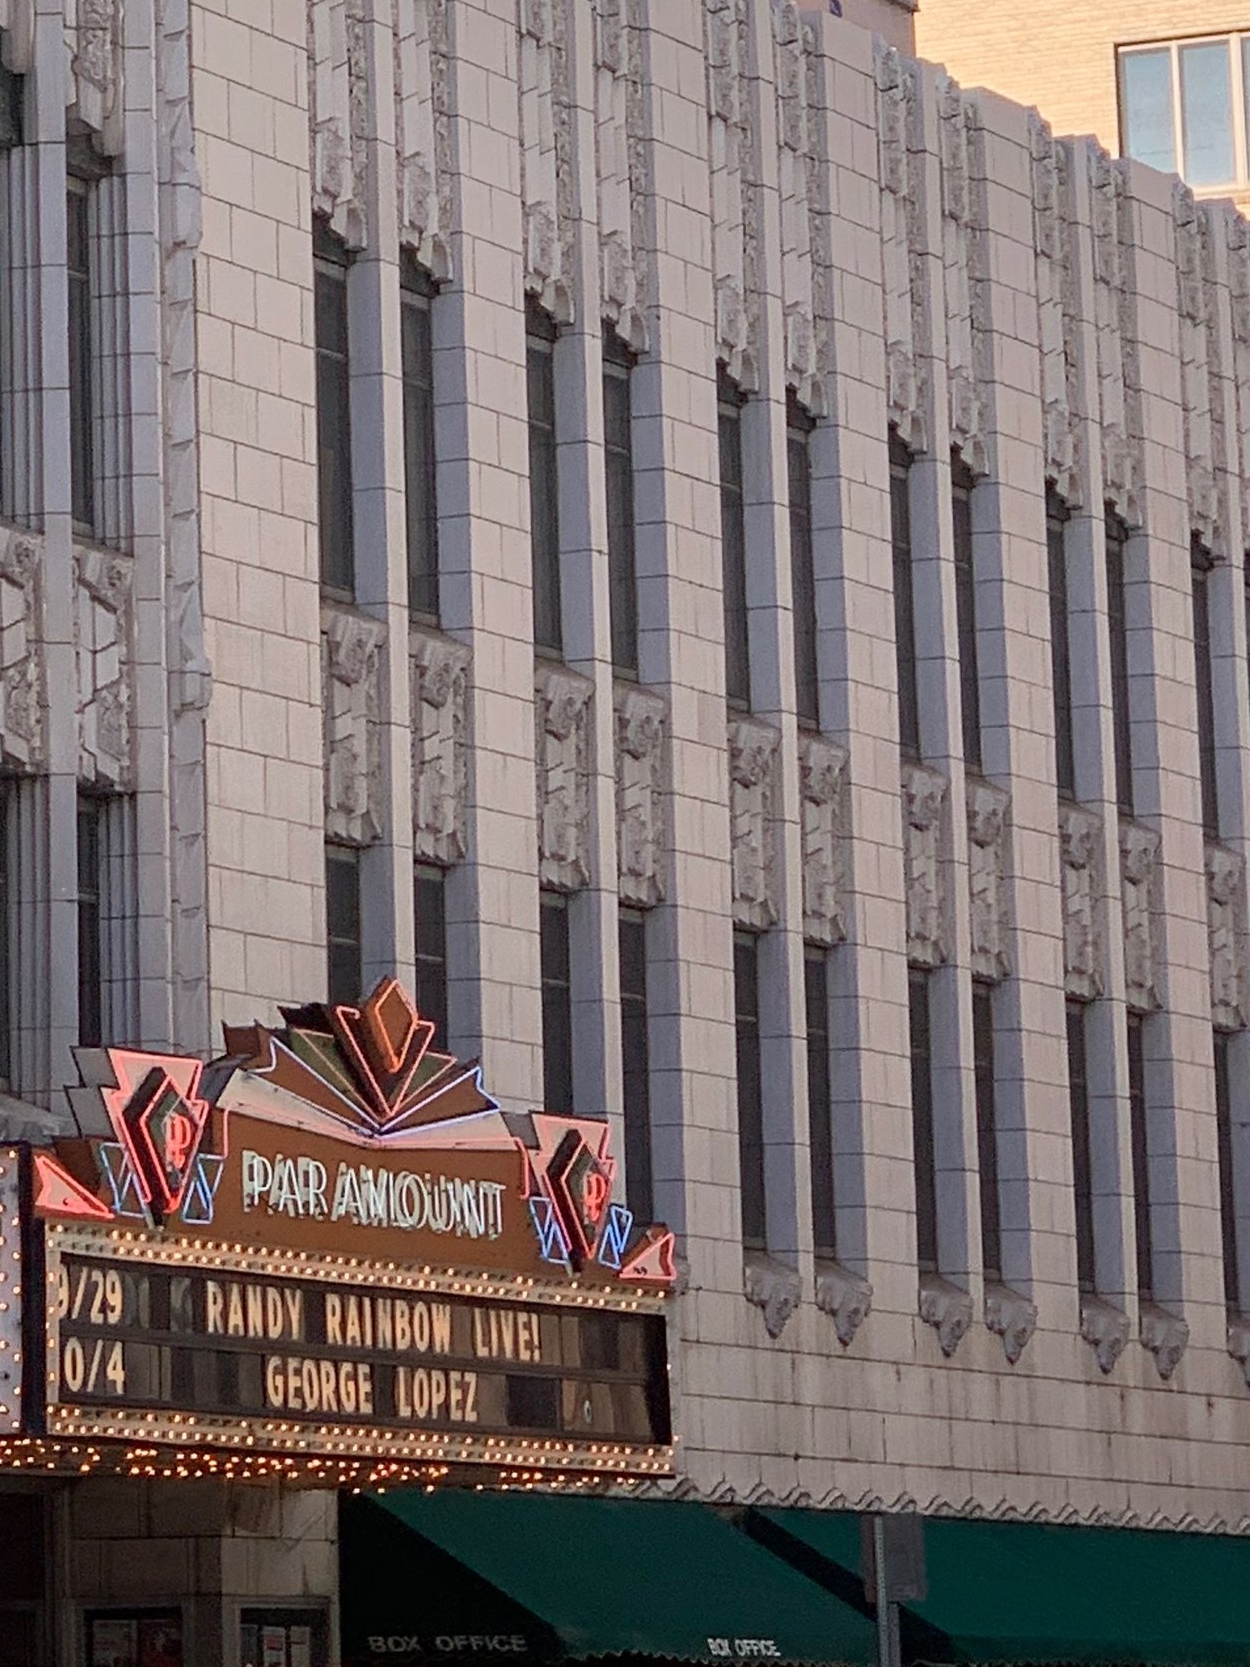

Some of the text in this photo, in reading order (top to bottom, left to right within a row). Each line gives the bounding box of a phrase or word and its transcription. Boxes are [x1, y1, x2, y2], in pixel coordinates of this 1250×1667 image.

[241, 1148, 506, 1241] PARAMOUNT
[207, 1280, 303, 1340] RANDY
[325, 1292, 450, 1354] RAINBOW
[474, 1307, 541, 1361] LIVE!
[266, 1355, 373, 1415] GEORGE
[396, 1365, 478, 1423] LOPEZ
[367, 1634, 529, 1653] BOX OFFICE
[707, 1637, 782, 1657] BOX OFFICE
